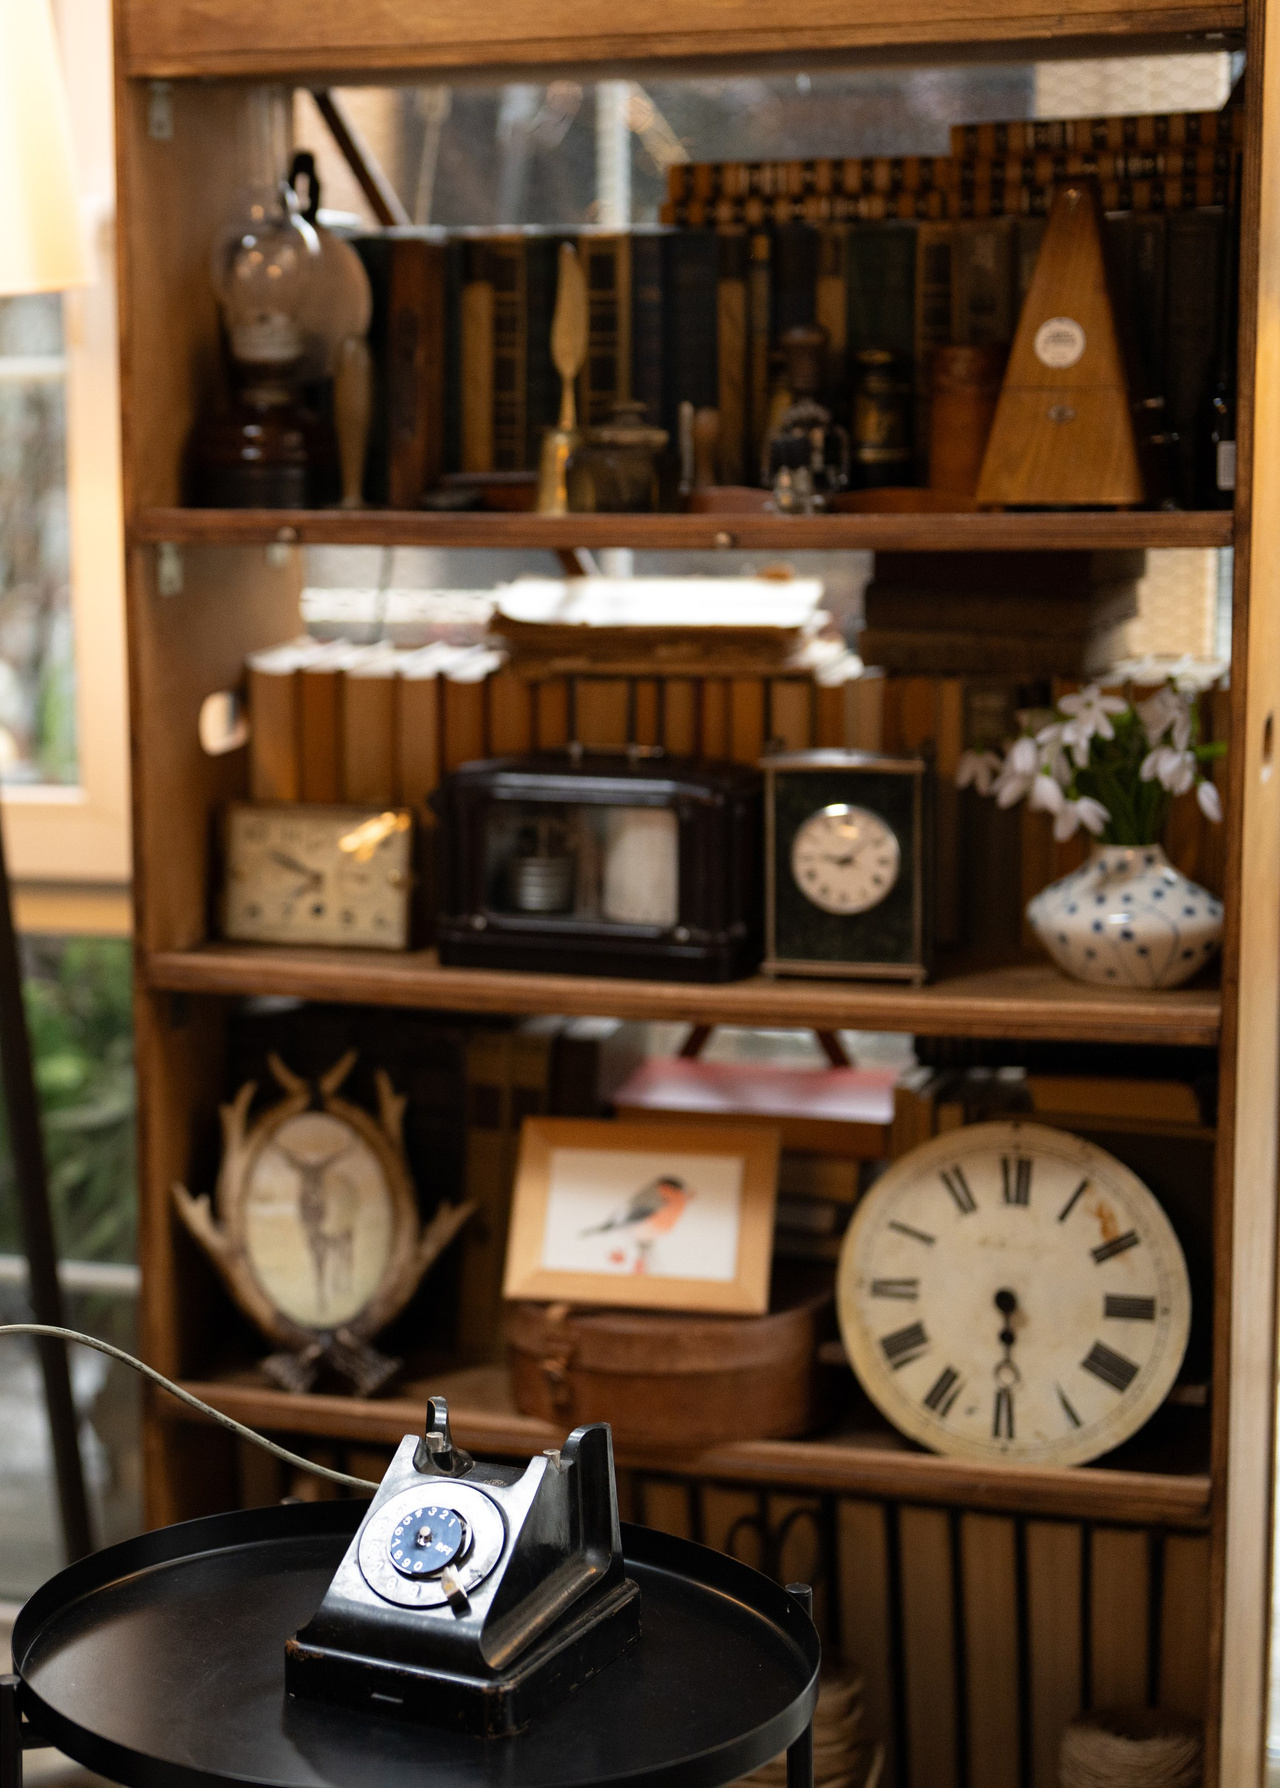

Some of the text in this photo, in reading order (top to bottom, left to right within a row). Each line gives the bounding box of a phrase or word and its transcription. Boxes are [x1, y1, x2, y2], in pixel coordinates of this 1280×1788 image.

[428, 1507, 437, 1516] 3
[439, 1510, 449, 1520] 2
[403, 1515, 413, 1526] 5
[395, 1526, 404, 1536] 6
[392, 1538, 401, 1548] 7
[394, 1549, 403, 1560] 8
[402, 1557, 412, 1568] 9
[413, 1560, 424, 1571] 0
